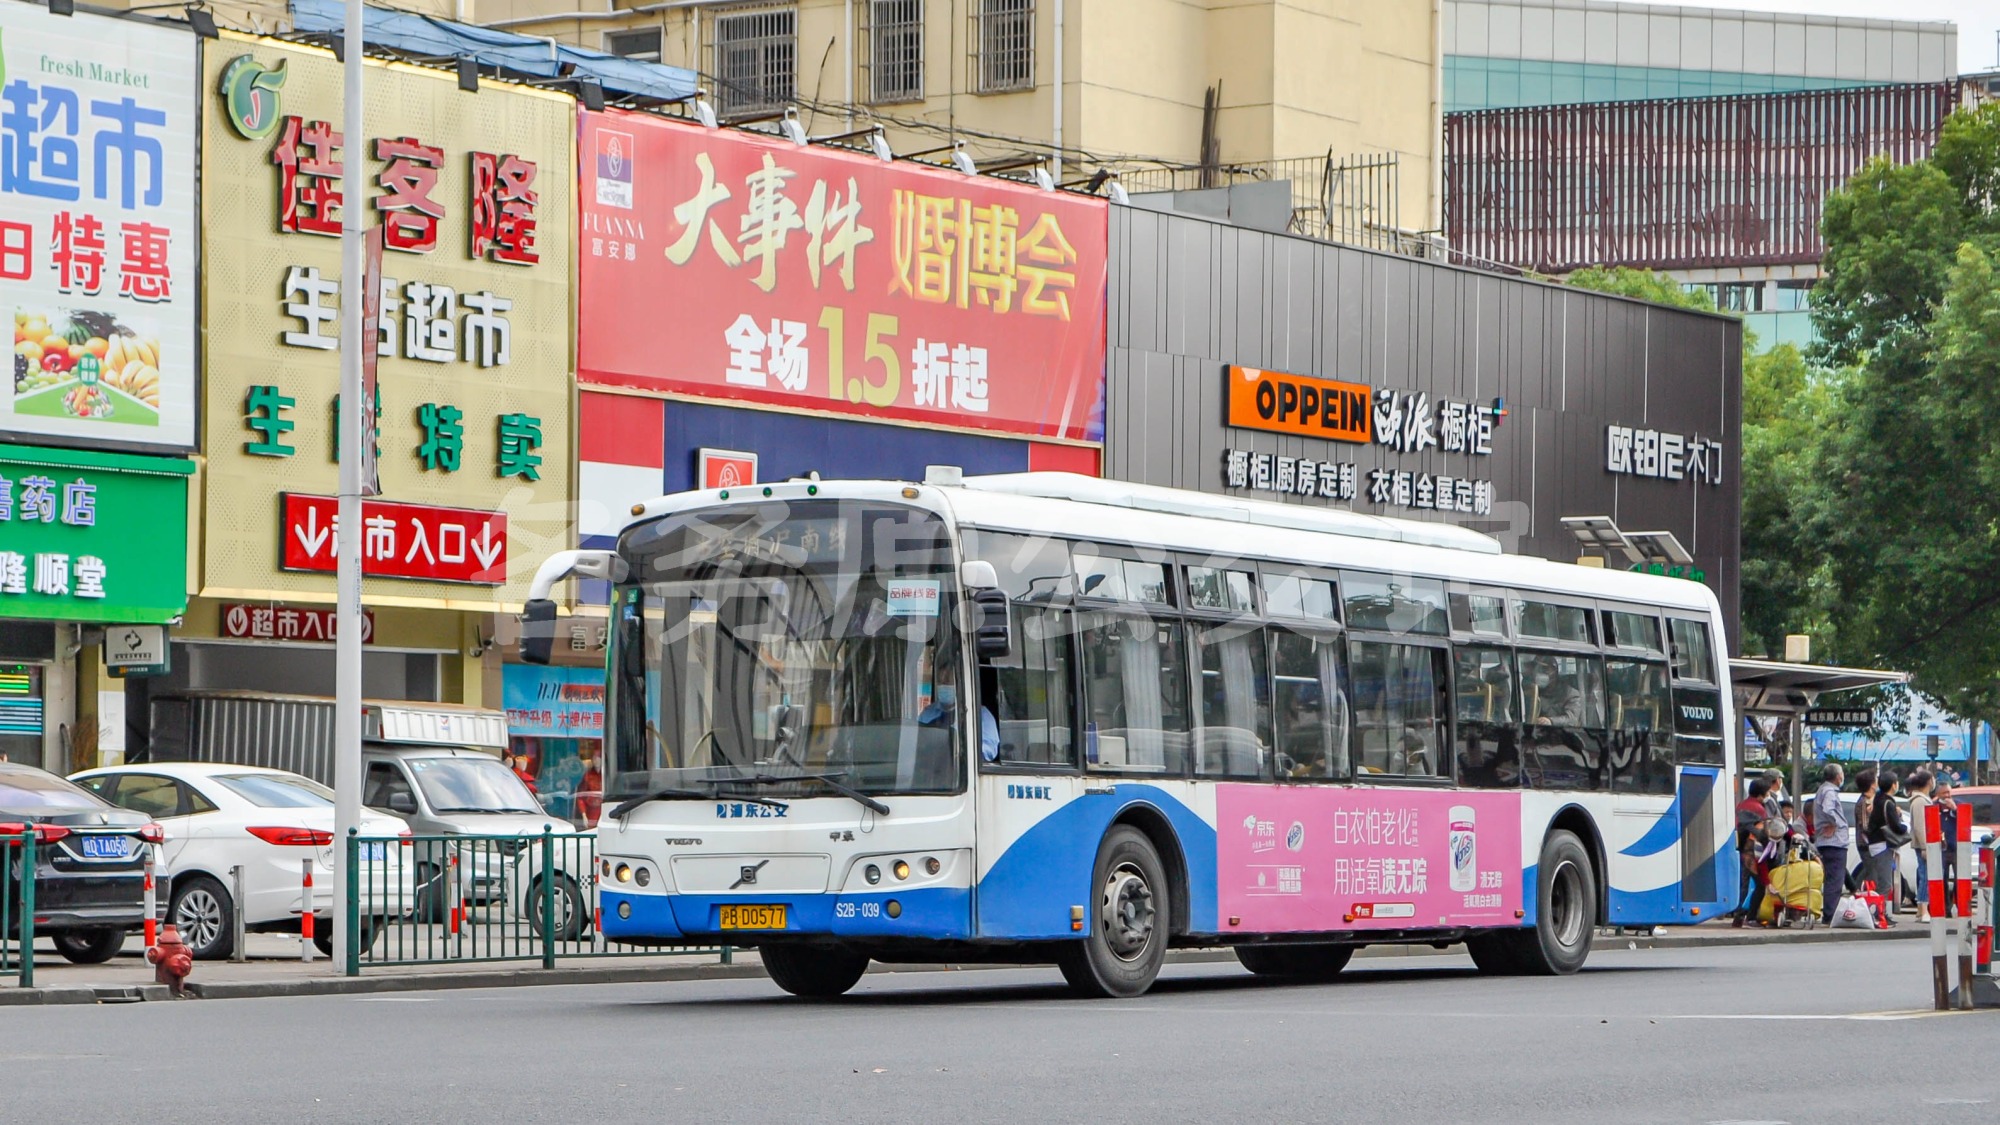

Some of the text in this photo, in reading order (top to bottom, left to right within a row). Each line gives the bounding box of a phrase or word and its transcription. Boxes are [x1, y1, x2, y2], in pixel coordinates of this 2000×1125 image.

[40, 54, 149, 89] fresh Market
[1, 79, 166, 209] 超市
[274, 115, 539, 265] 佳客隆
[583, 211, 645, 240] FUANNA
[664, 151, 1077, 321] 大事件 婚博会
[592, 237, 636, 261] 富安娜
[1256, 379, 1366, 432] OPPEIN
[246, 385, 542, 481] 生特卖
[1441, 400, 1493, 454] 橱柜
[1607, 423, 1723, 485] 欧铂尼木门
[331, 514, 466, 566] 市入口
[537, 682, 561, 700] 11.11
[1681, 705, 1713, 720] VOLVO
[1257, 821, 1275, 836] 京东
[1334, 807, 1411, 846] 白衣怕老化
[1334, 857, 1427, 895] 用活氧渍无踪
[1480, 871, 1502, 889] 渍无踪
[836, 903, 880, 918] S2B-039
